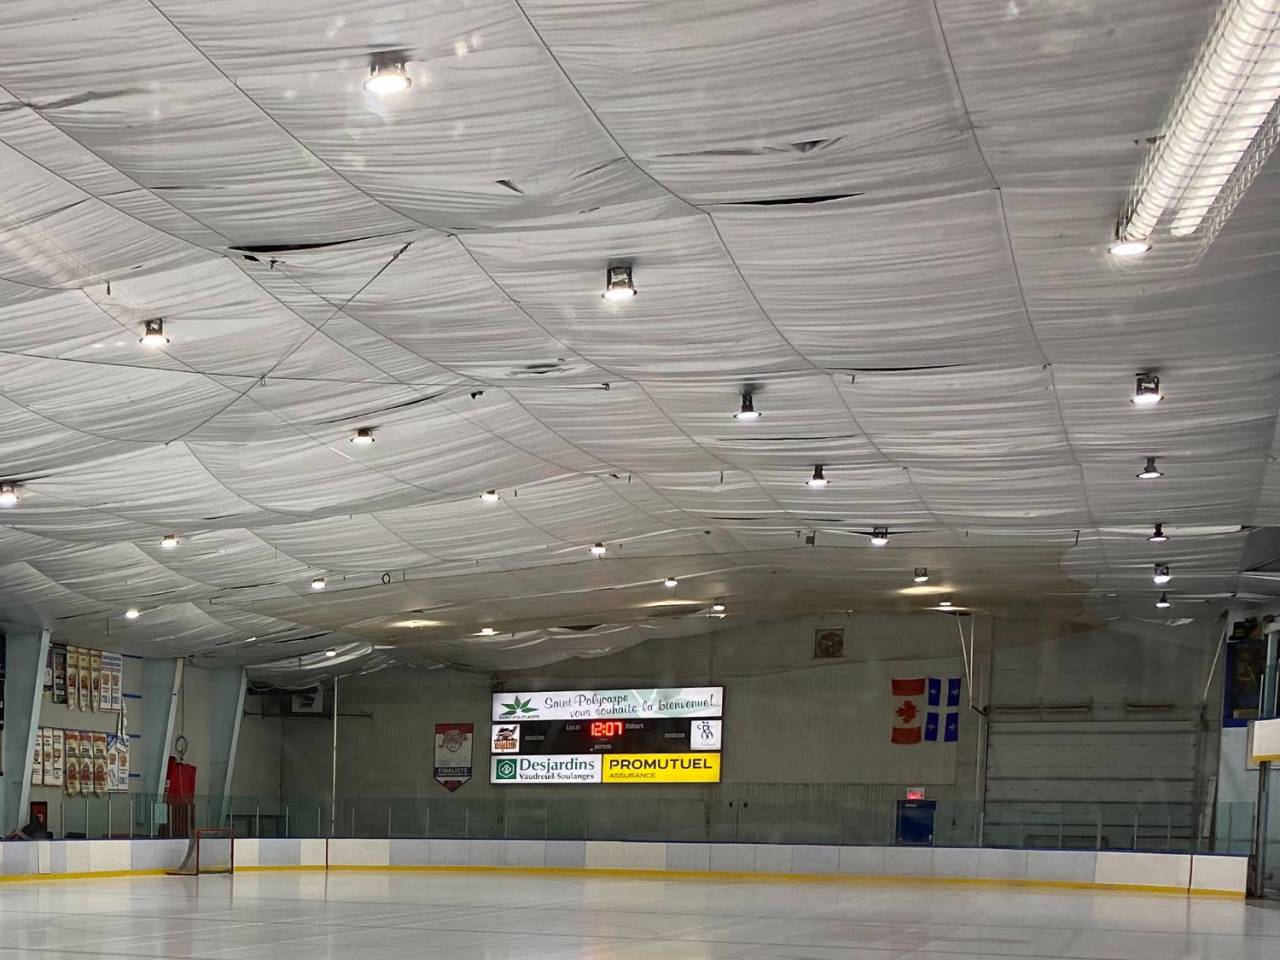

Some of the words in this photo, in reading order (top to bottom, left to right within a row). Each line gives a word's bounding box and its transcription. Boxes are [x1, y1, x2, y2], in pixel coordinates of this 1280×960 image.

[570, 708, 592, 719] vous
[596, 701, 638, 716] souhaite
[642, 702, 654, 713] la
[658, 693, 714, 711] bienvenue!
[590, 721, 623, 737] 12:07
[519, 758, 595, 774] Desjardins
[609, 757, 713, 771] PROMUTUEL
[519, 772, 595, 782] Vaudreuil-Soulanges
